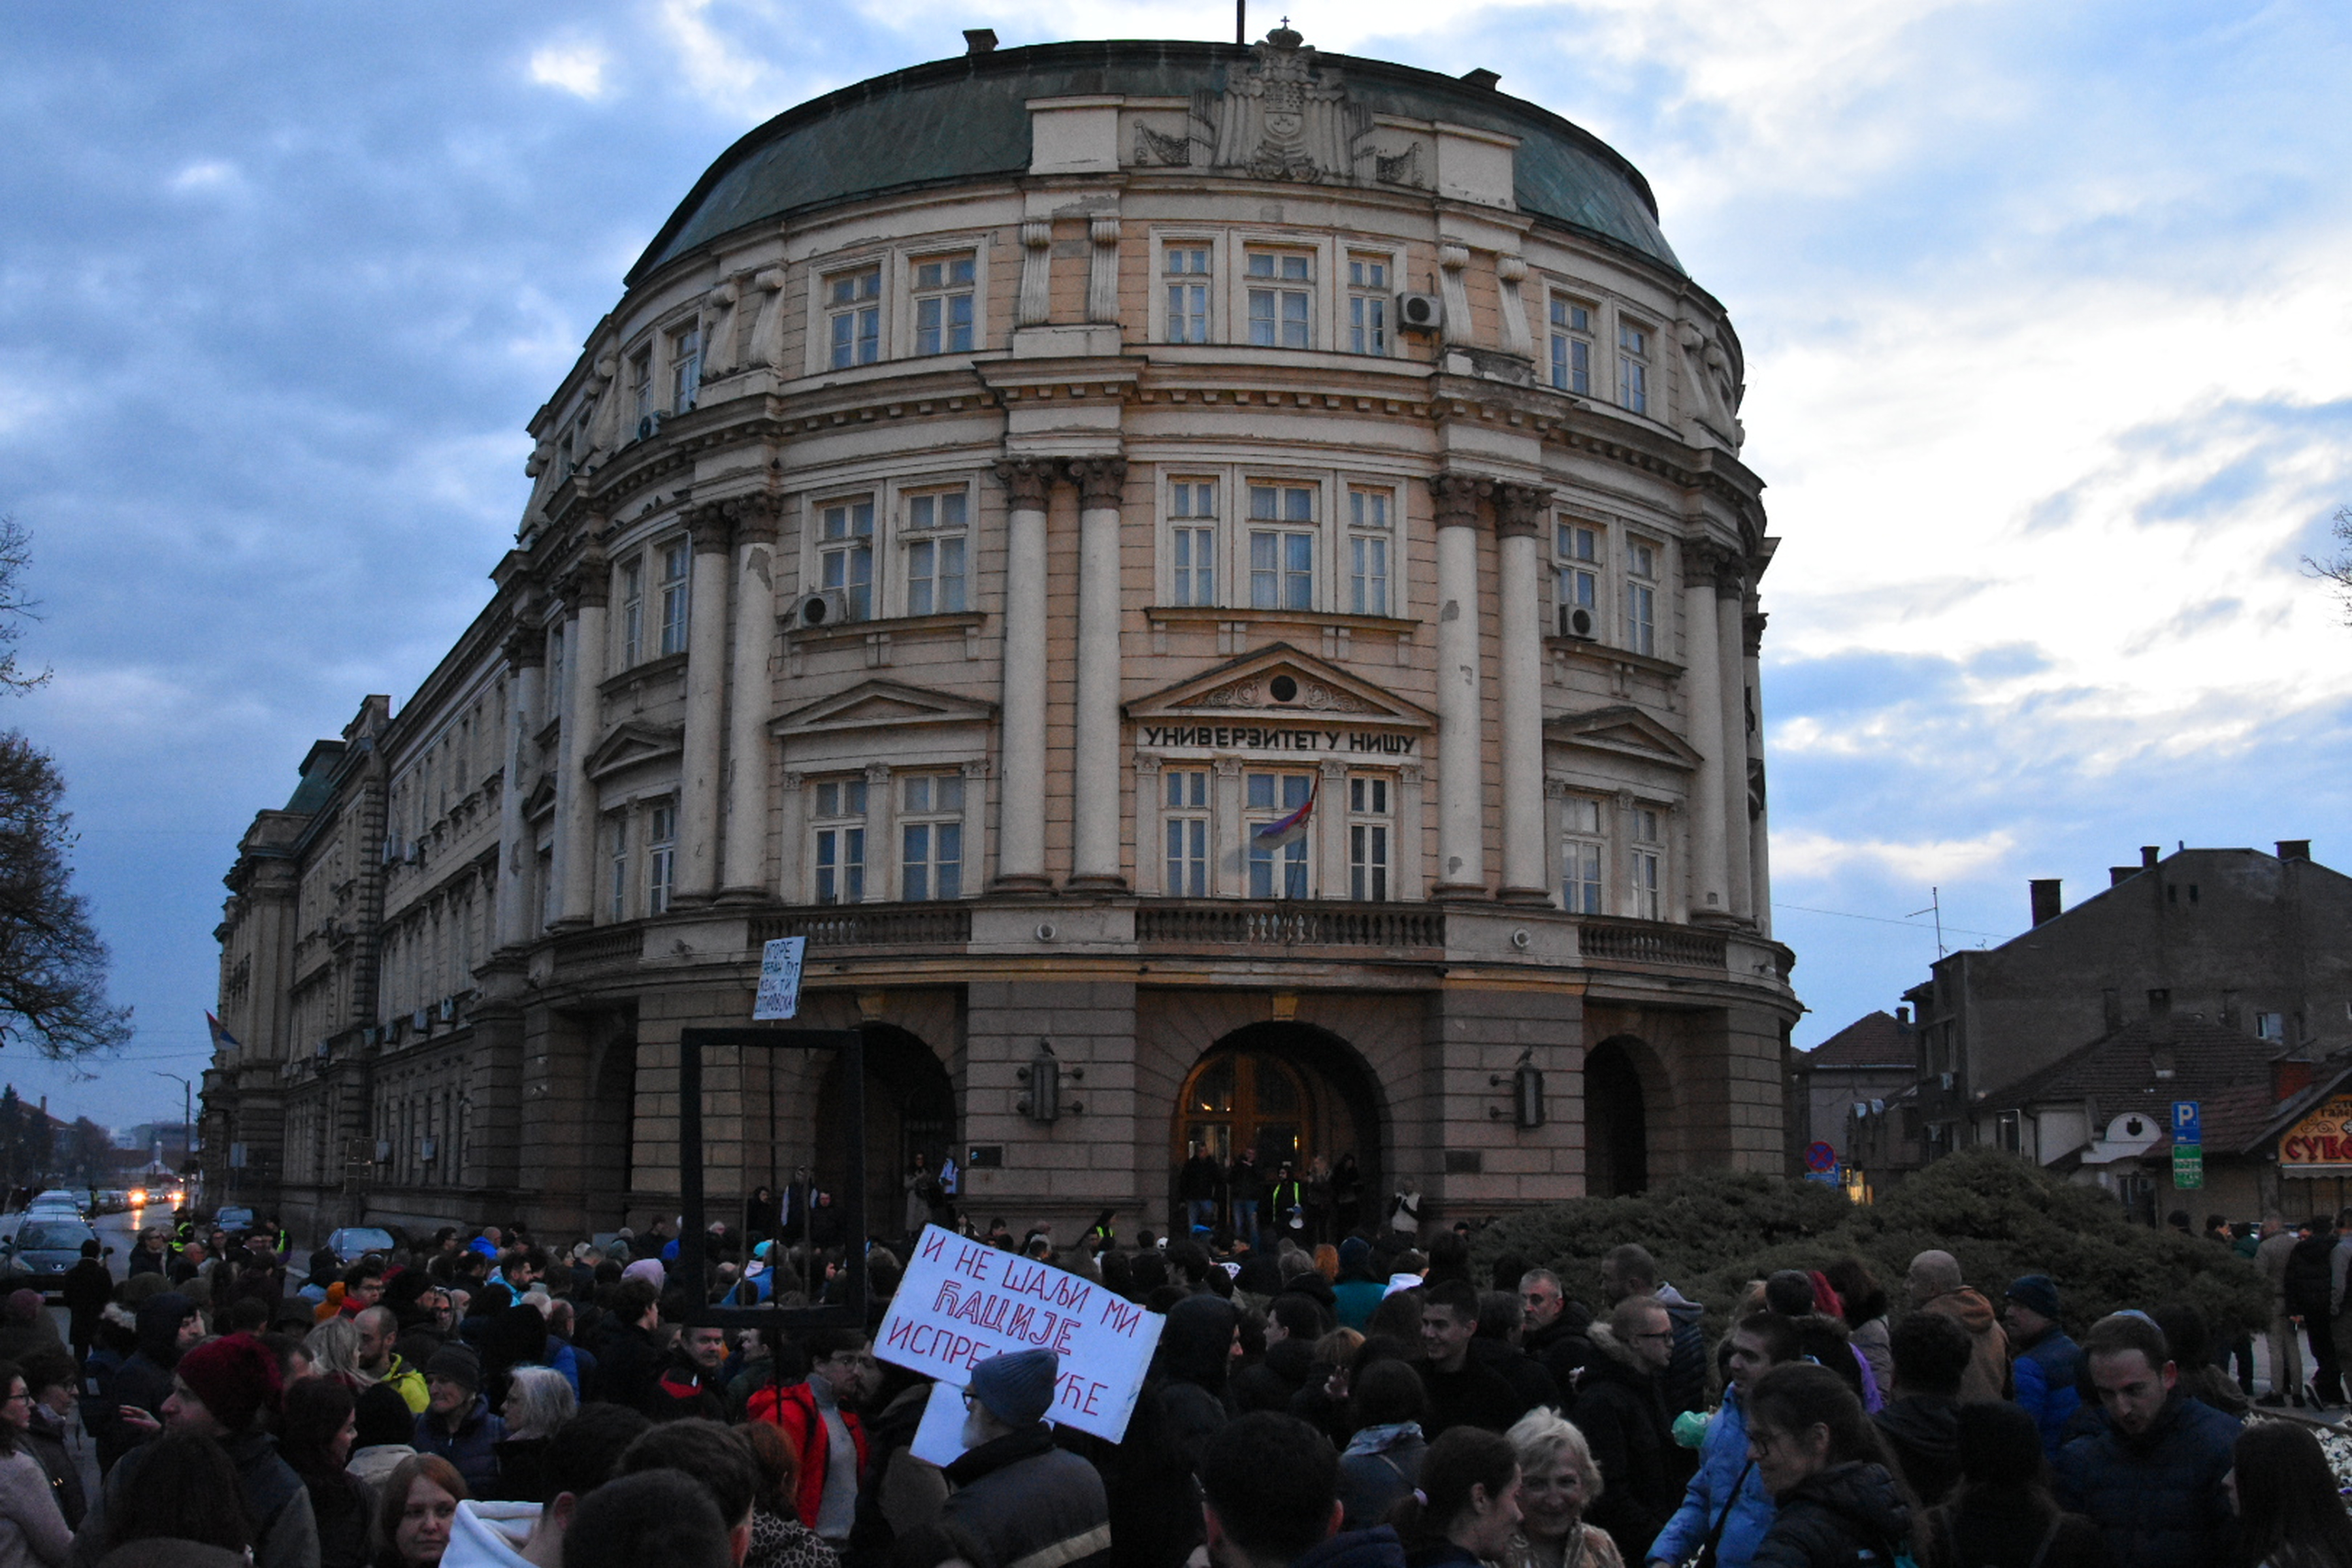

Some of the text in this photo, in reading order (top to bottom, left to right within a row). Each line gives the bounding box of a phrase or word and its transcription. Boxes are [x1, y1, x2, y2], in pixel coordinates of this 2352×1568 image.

[1144, 727, 1416, 753] УНИВЕРЗИТЕТ У НИШУ
[2178, 1104, 2194, 1126] P
[922, 1232, 1142, 1338] И НЕ ШАЉИ МИ
[887, 1316, 1004, 1371] ИСПРЕ
